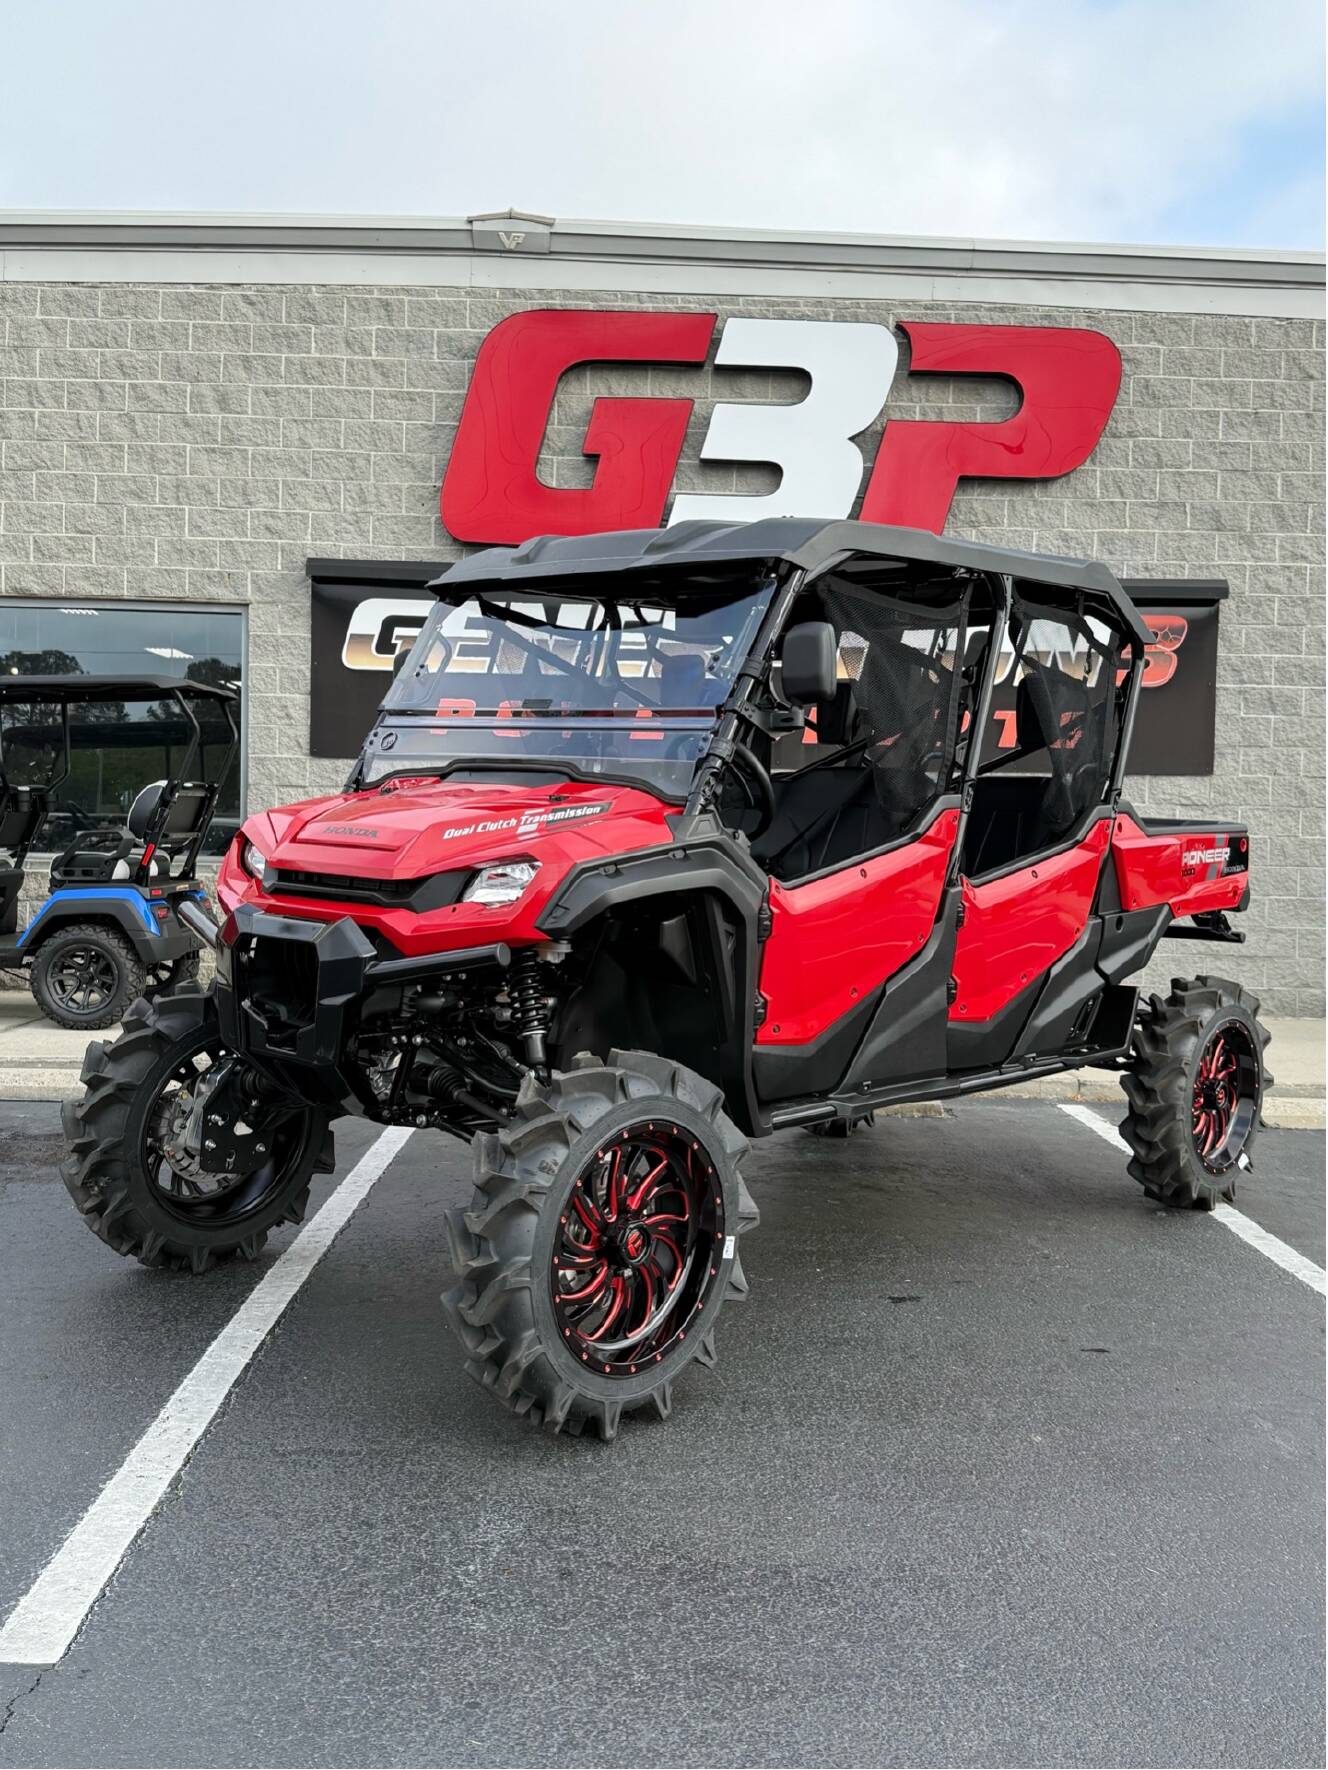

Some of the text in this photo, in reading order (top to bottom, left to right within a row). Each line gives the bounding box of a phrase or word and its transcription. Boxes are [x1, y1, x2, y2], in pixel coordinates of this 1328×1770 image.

[440, 308, 1123, 544] G3P
[323, 825, 378, 838] HONDA
[442, 806, 601, 840] Dual Clutch Transmission
[1182, 847, 1231, 867] PIONEER
